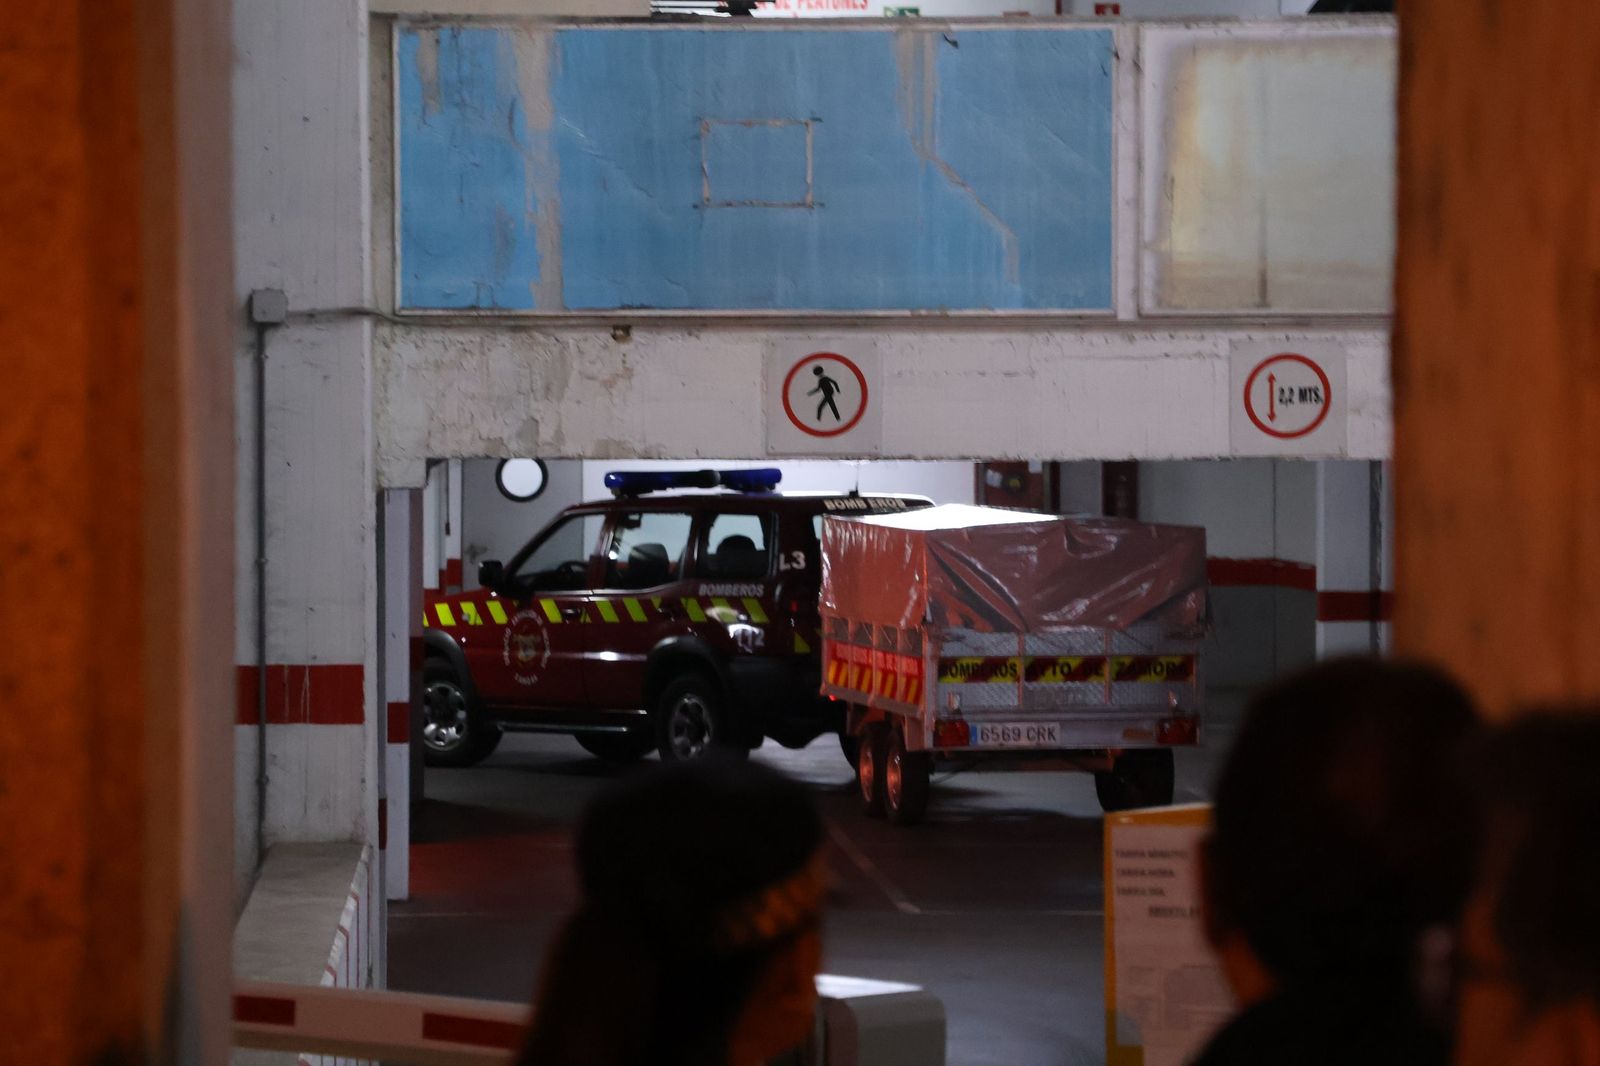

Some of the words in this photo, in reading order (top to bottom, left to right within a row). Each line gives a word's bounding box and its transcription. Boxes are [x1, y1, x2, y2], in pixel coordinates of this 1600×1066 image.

[779, 550, 806, 570] L3
[699, 584, 765, 598] BOMBEROS
[981, 726, 1022, 743] 6569
[1026, 726, 1058, 743] CRK
